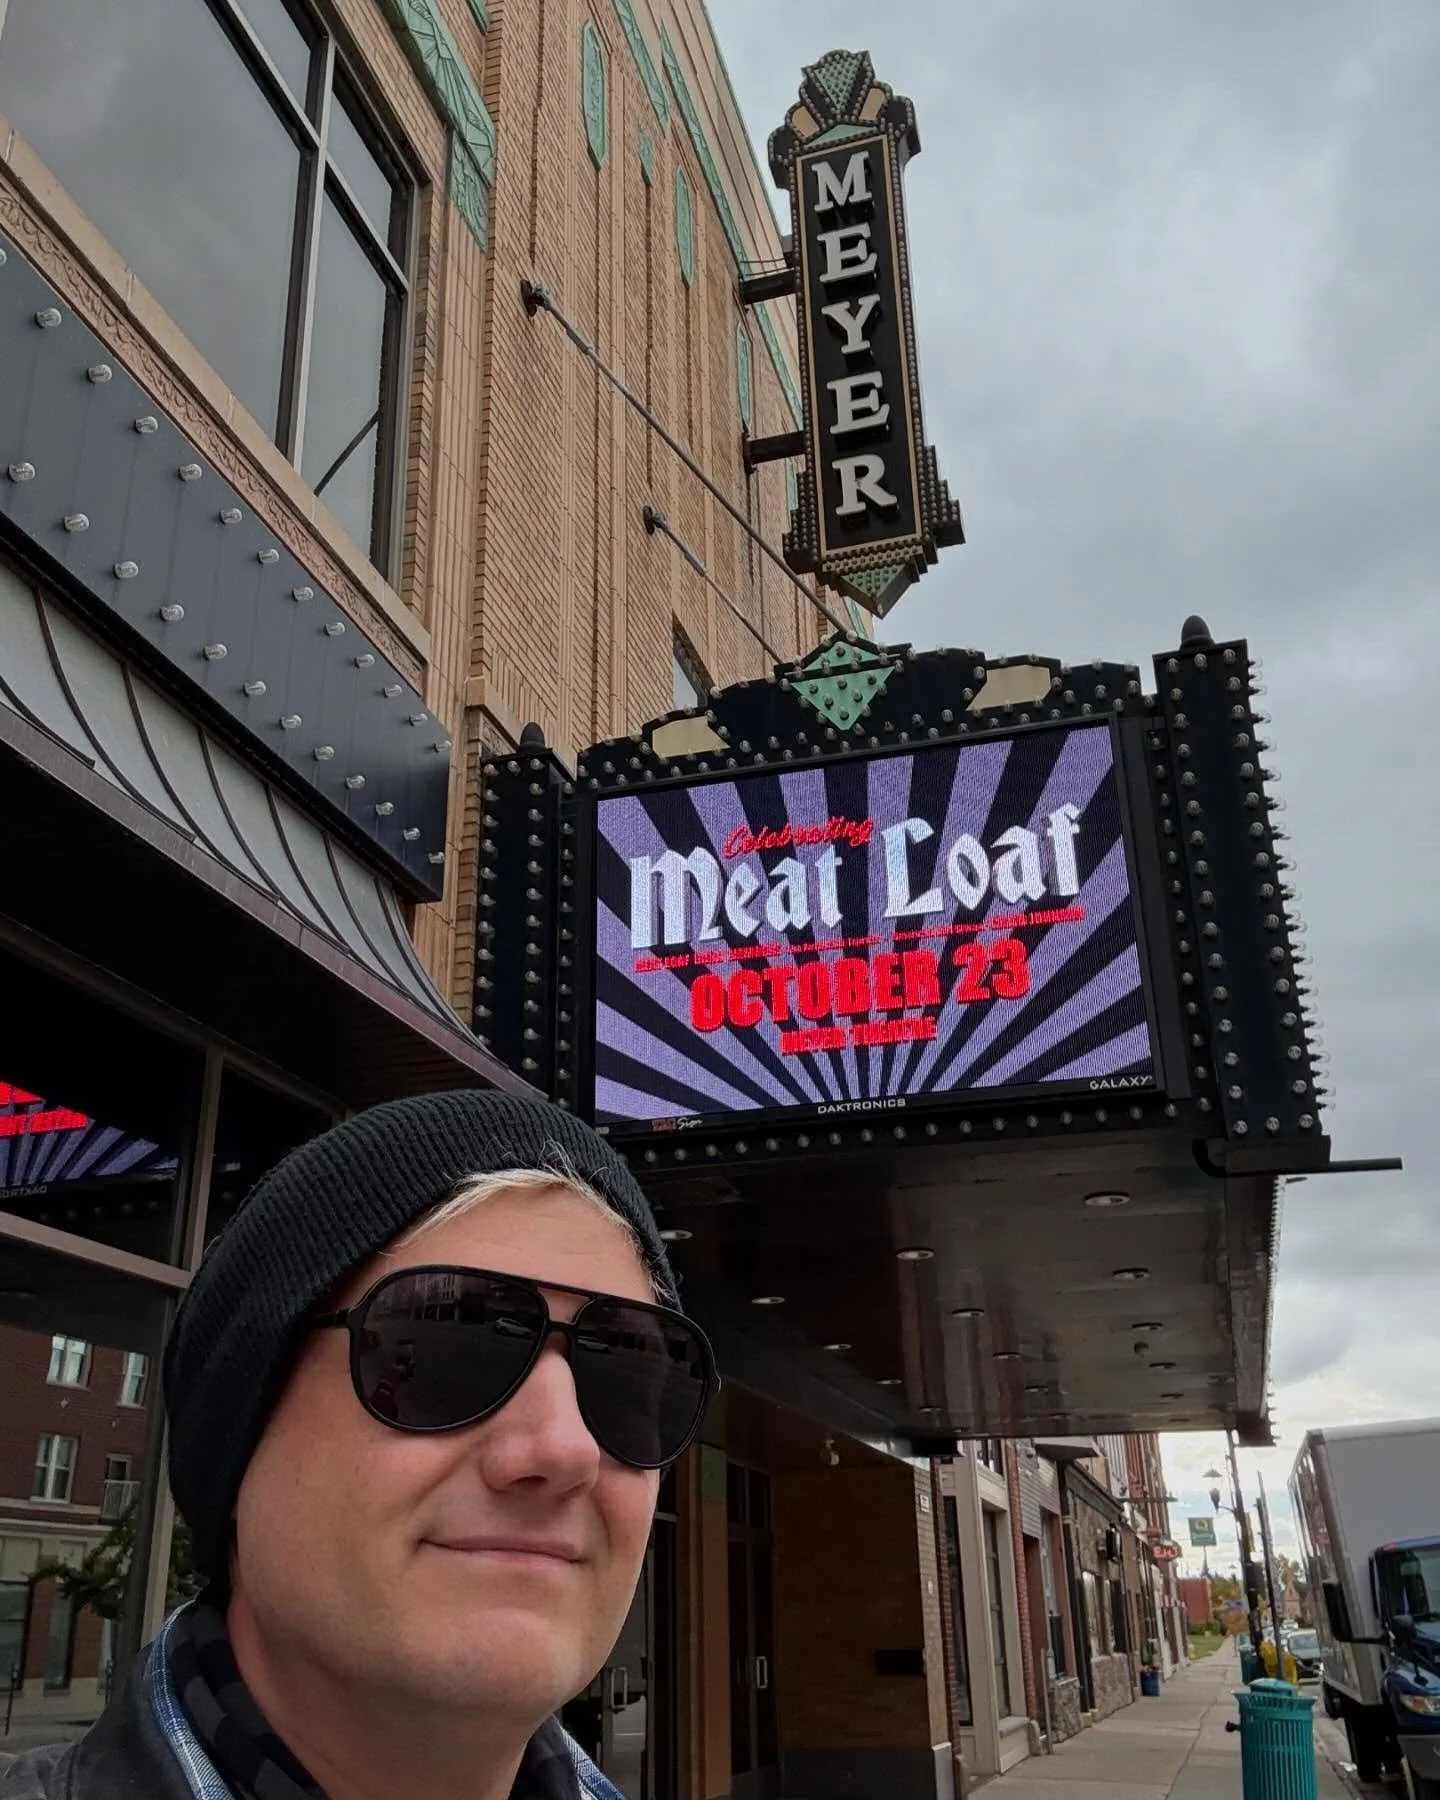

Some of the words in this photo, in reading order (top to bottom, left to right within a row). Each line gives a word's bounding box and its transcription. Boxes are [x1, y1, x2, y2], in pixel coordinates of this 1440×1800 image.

[812, 150, 898, 517] MEYER
[629, 846, 843, 949] Meat
[881, 802, 1080, 917] Loaf
[723, 815, 874, 860] Celebrating
[689, 949, 941, 1033] OCTOBER
[952, 937, 1031, 1004] 23
[817, 1098, 906, 1114] DAKTRONICS
